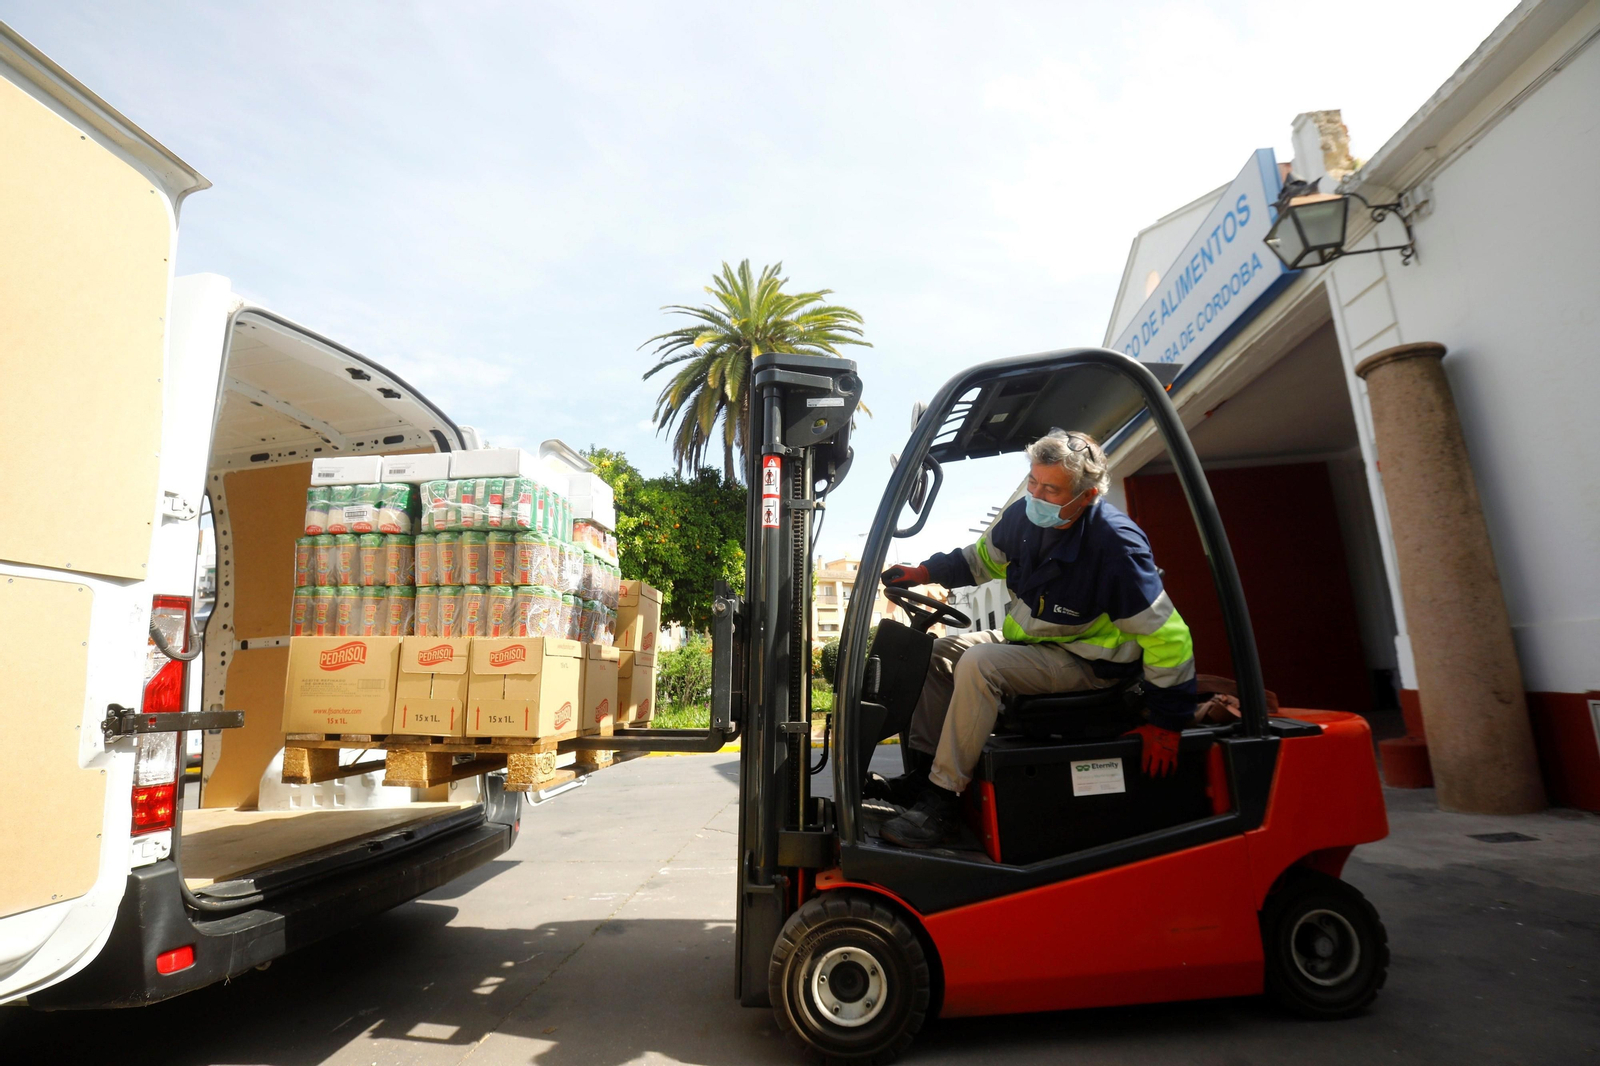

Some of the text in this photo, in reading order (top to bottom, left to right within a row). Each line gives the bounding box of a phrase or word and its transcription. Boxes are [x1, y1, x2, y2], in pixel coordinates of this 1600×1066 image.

[1141, 310, 1159, 346] DE
[1161, 193, 1251, 325] ALIMENTOS
[1179, 322, 1196, 350] DE
[1196, 252, 1263, 332] CORDOBA
[415, 714, 423, 722] 15
[488, 715, 497, 723] 15
